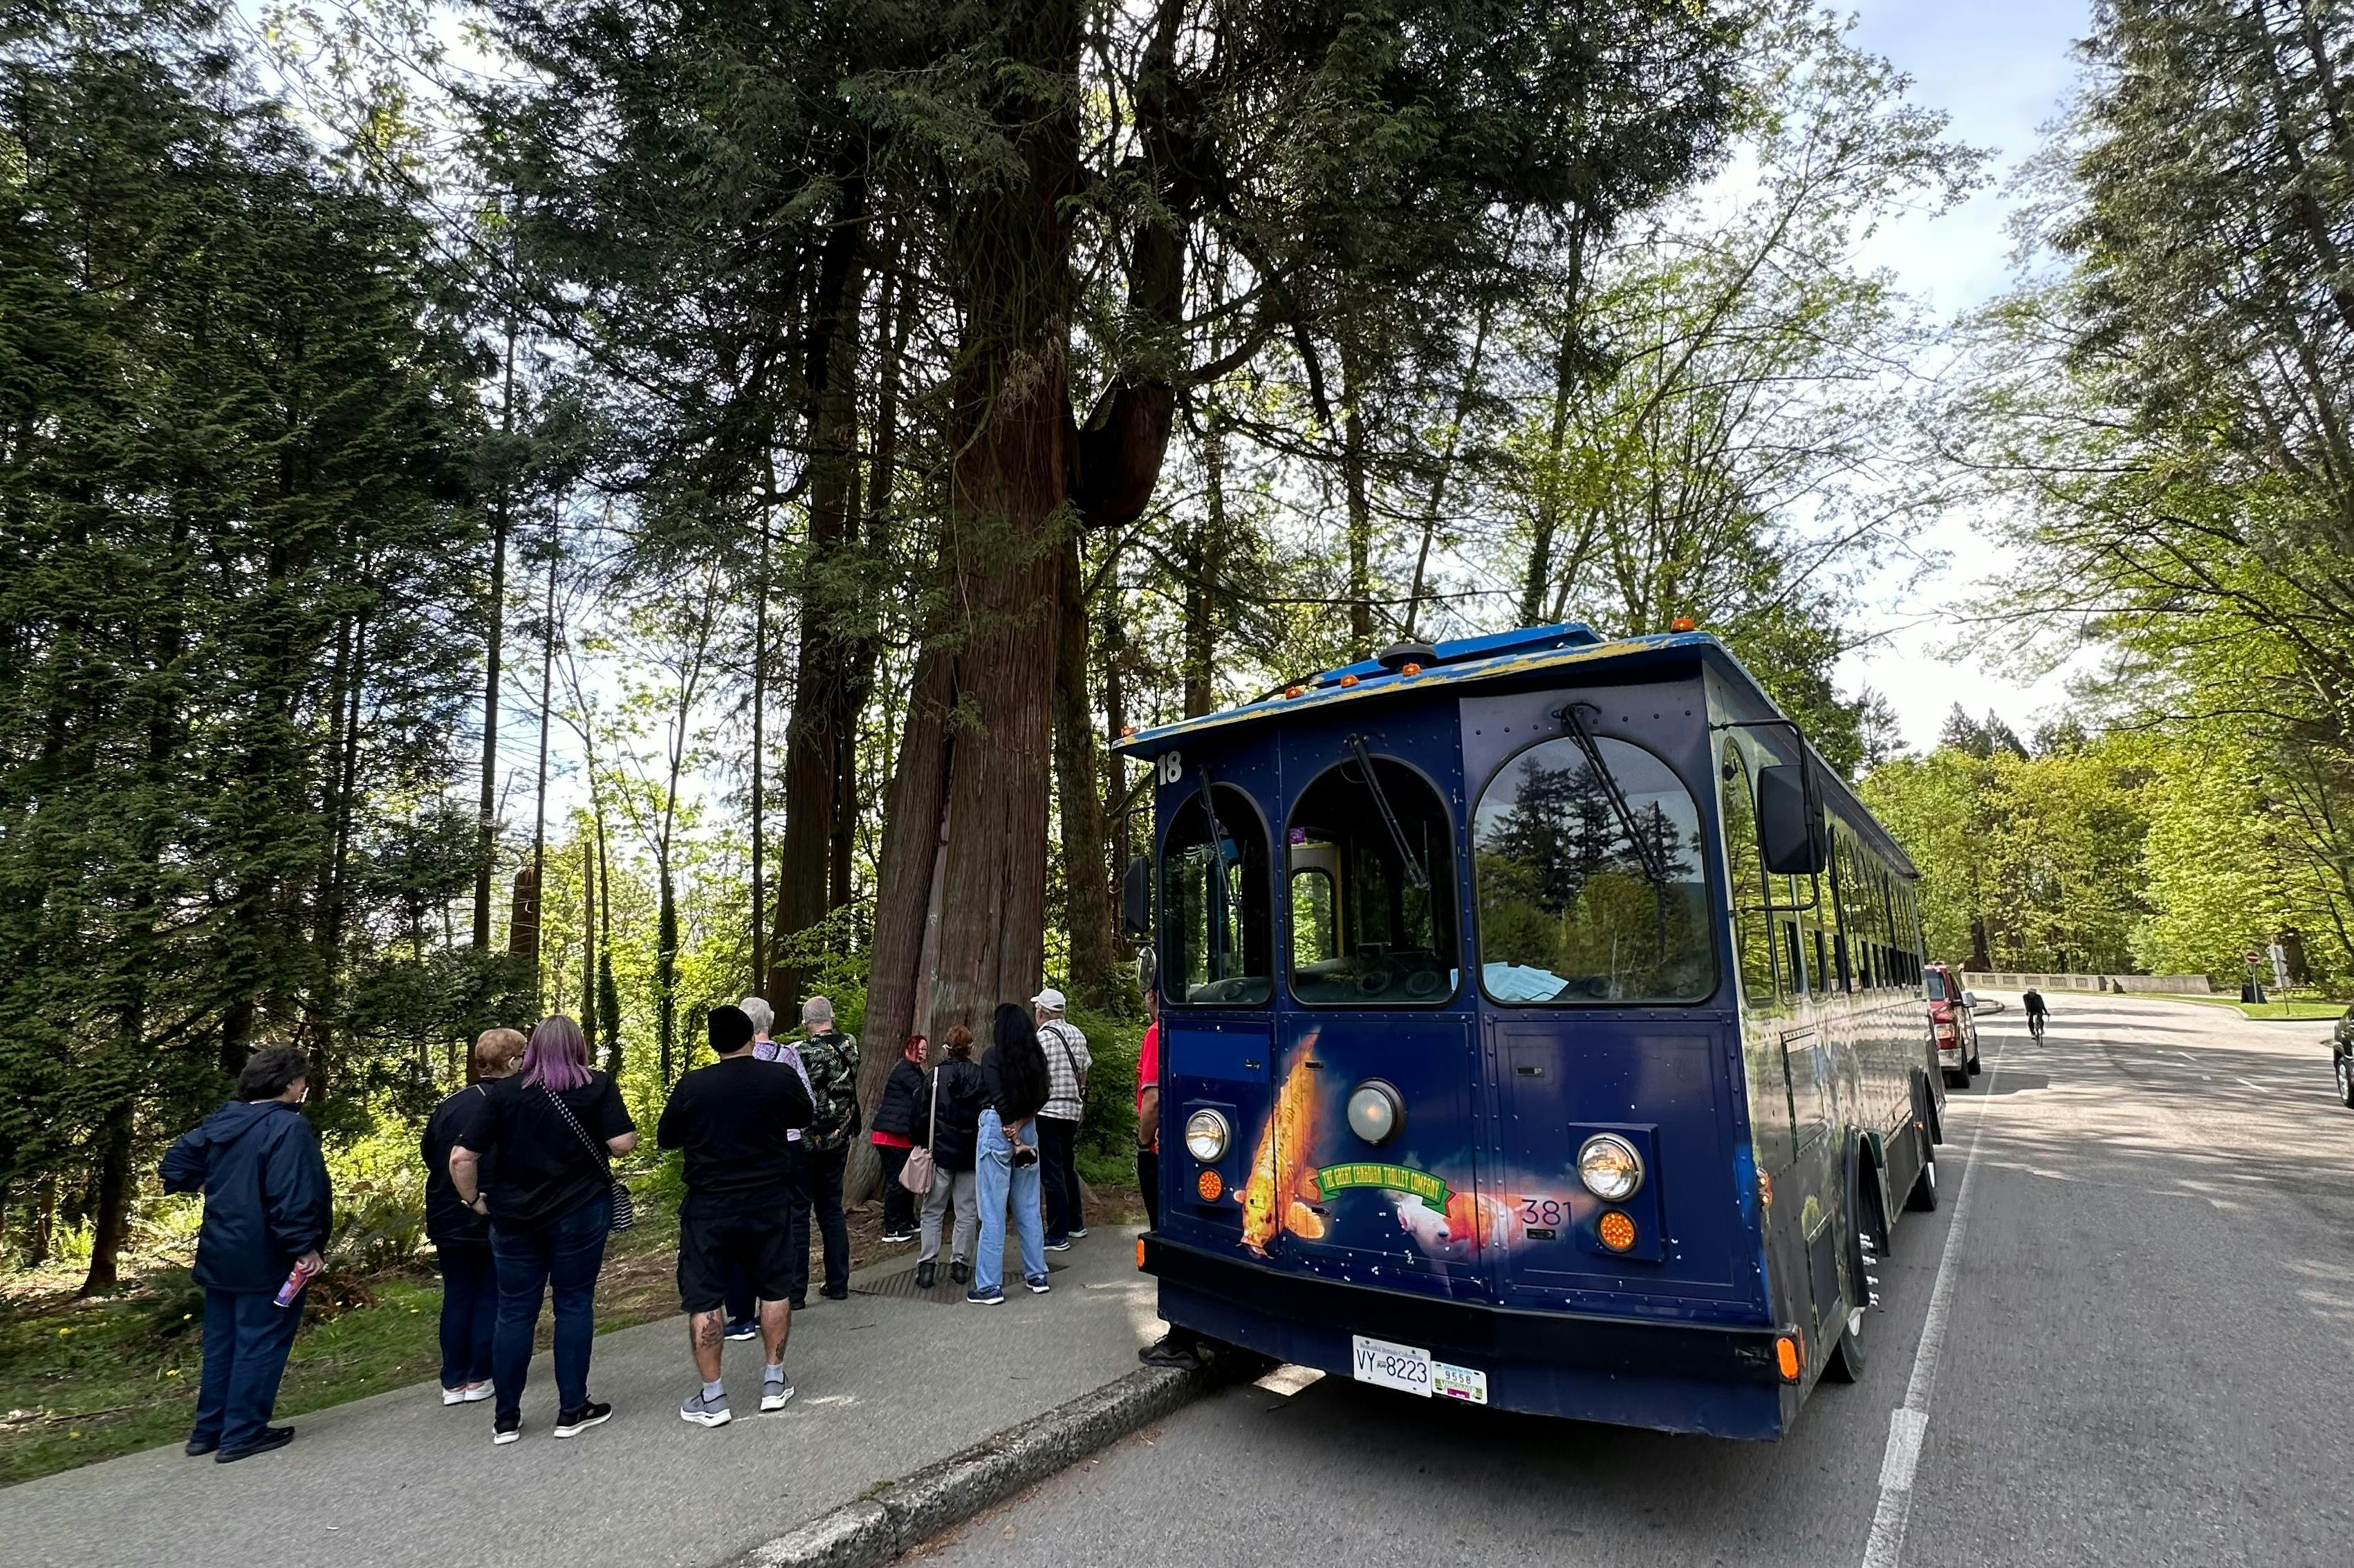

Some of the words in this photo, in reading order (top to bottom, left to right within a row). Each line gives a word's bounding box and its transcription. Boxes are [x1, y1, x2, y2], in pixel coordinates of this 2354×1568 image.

[1157, 751, 1182, 785] 18
[1322, 1170, 1334, 1189] THE
[1334, 1166, 1352, 1186] GREAT
[1353, 1165, 1382, 1184] CANADIAN
[1383, 1166, 1409, 1188] TROLLEY
[1411, 1173, 1440, 1200] COMPANY
[1521, 1198, 1572, 1227] 381
[1356, 1349, 1375, 1372] VY
[1387, 1356, 1427, 1383] 8223
